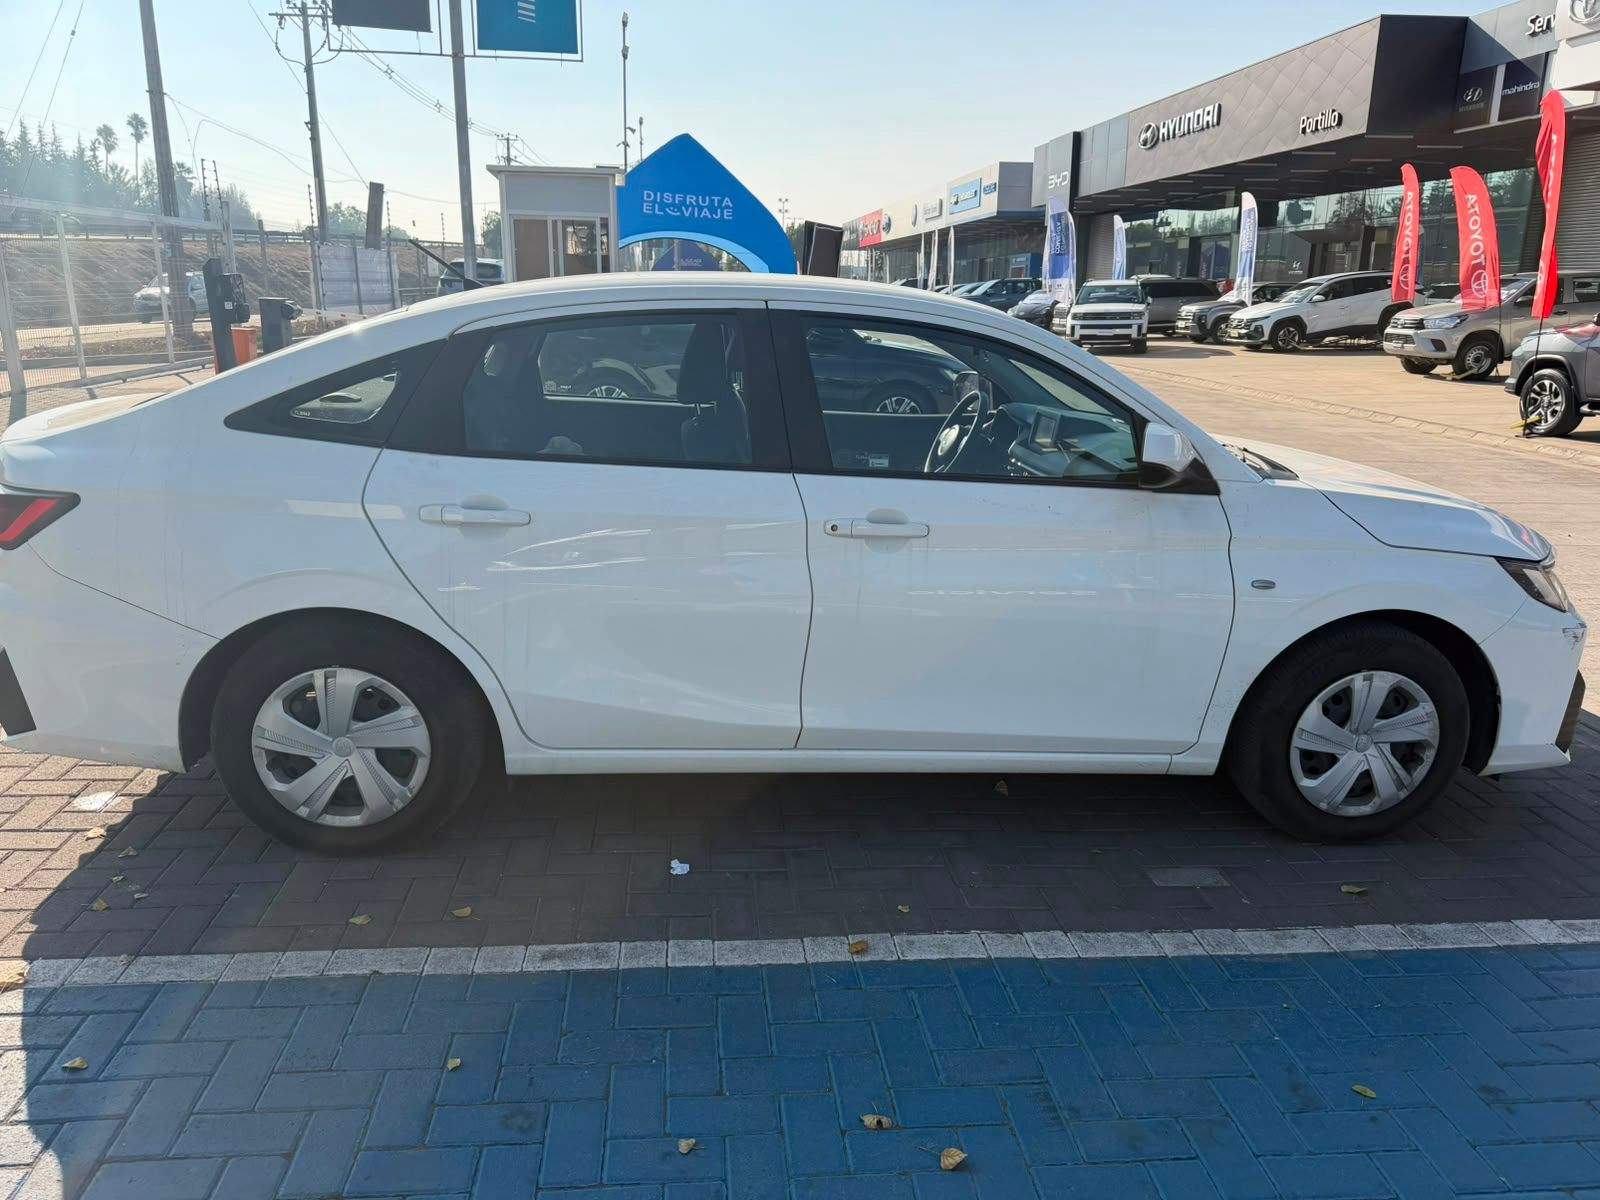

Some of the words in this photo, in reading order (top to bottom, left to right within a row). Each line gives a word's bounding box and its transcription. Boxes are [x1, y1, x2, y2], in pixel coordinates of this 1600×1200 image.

[1502, 81, 1540, 96] mahindra
[1160, 103, 1219, 140] HYUNDAI
[1299, 108, 1339, 134] Portillo
[1048, 171, 1069, 189] BYD
[643, 190, 733, 208] DISFRUTA
[643, 203, 664, 215] EL
[682, 206, 733, 220] VIAJE
